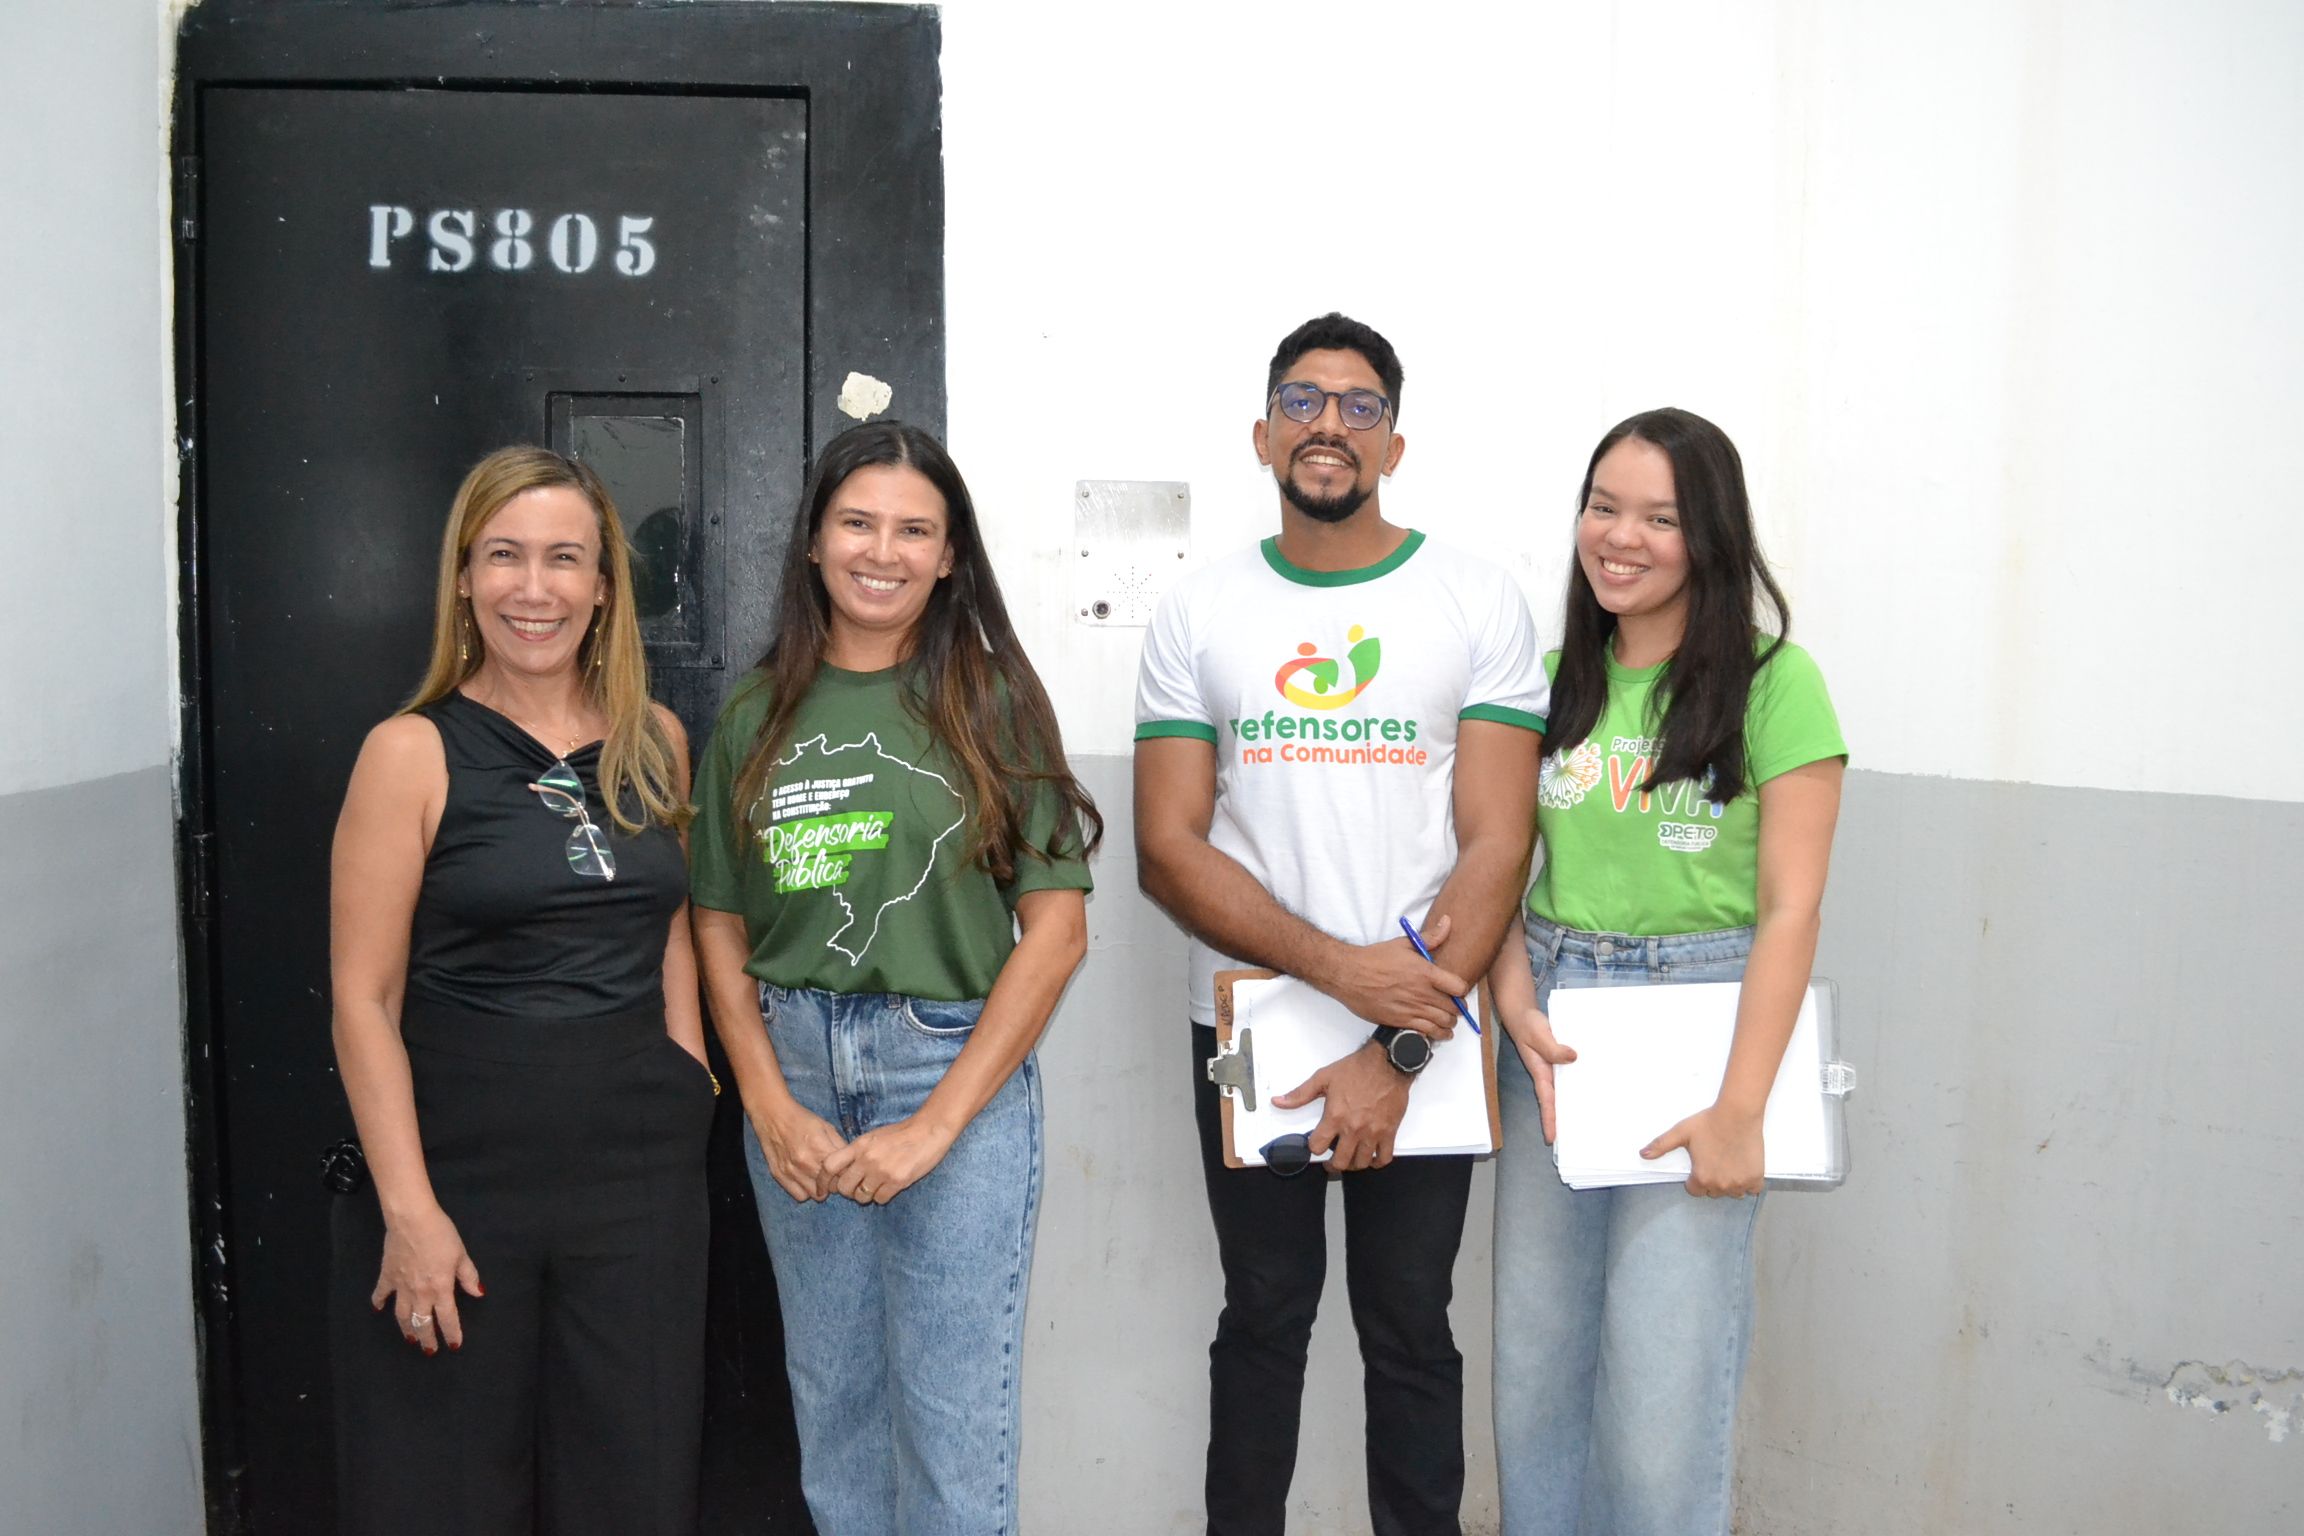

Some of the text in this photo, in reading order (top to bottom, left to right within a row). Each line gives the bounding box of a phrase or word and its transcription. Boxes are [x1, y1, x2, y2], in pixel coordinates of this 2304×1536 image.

[369, 205, 656, 276] PS805
[1243, 743, 1428, 766] na Comunidade
[772, 788, 778, 798] O
[811, 779, 841, 791] JUSTIÇA
[808, 792, 814, 801] E
[763, 814, 884, 865] Defensoria
